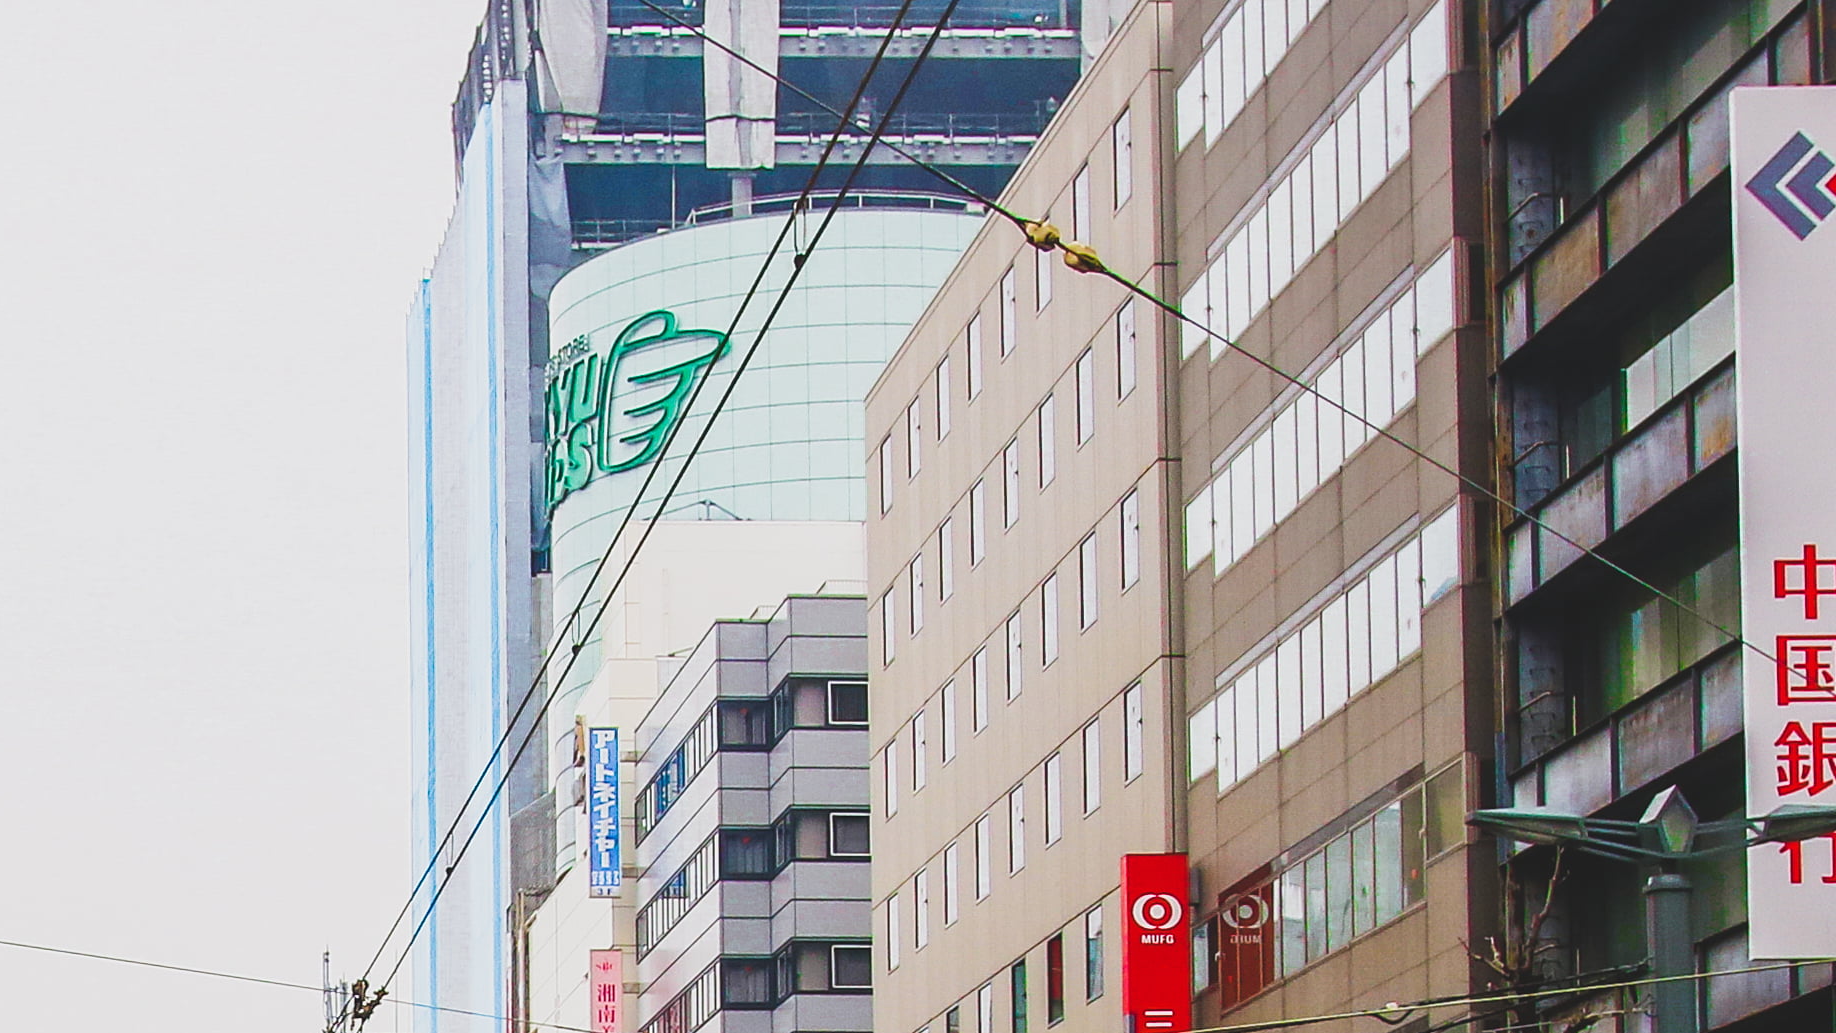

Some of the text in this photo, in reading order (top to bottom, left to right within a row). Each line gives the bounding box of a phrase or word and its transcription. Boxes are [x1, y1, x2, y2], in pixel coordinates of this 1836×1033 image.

[592, 729, 616, 869] アートネイチャー
[1141, 934, 1175, 944] MUFG
